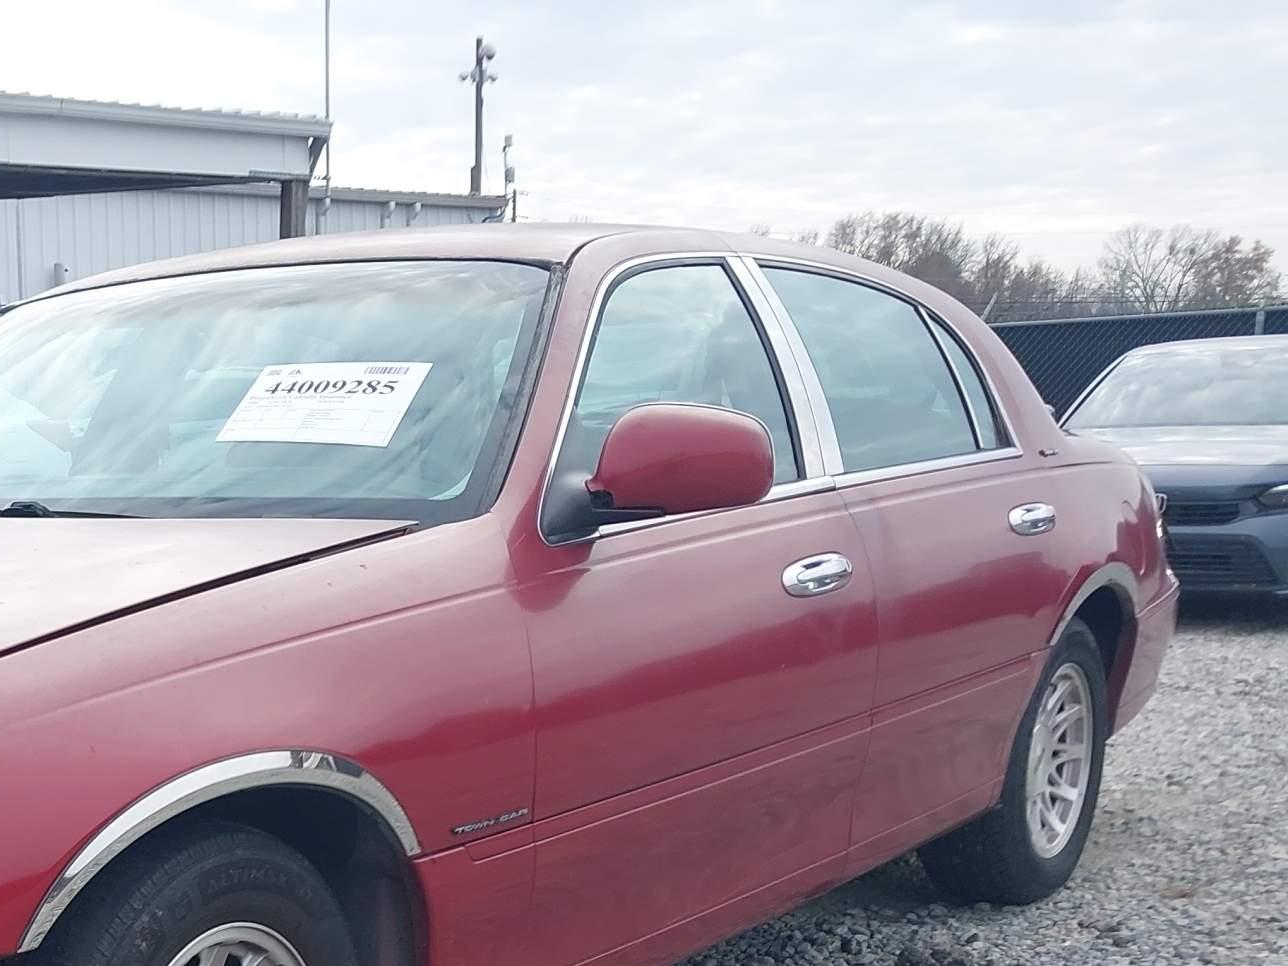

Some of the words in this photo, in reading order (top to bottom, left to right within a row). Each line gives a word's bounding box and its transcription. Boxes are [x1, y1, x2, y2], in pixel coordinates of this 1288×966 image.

[264, 379, 400, 395] 44009285
[452, 819, 494, 835] TOWN
[498, 808, 529, 823] CAR
